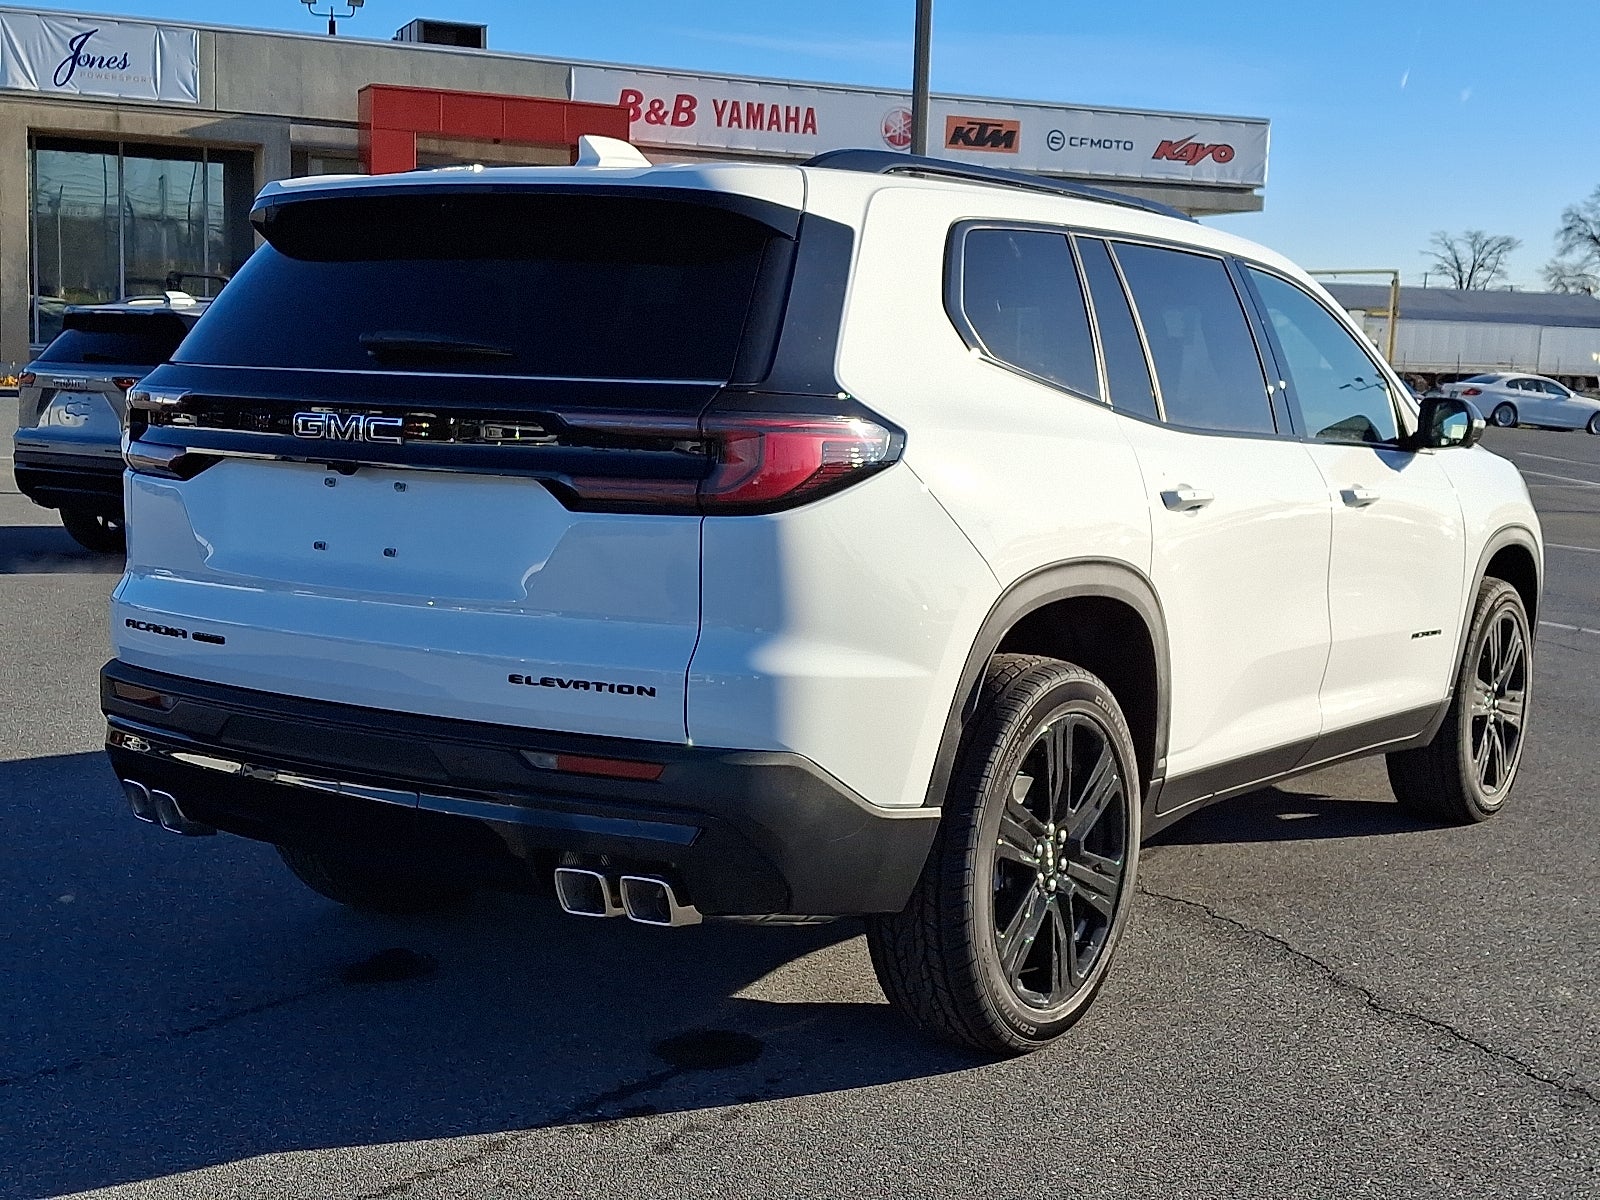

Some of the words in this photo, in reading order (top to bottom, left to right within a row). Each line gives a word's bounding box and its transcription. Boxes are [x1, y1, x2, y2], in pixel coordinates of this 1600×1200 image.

[53, 29, 131, 87] Jones
[619, 88, 698, 128] B&B
[712, 98, 818, 136] YAMAHA
[948, 121, 1017, 149] KTM
[1069, 136, 1134, 152] CFMOTO
[292, 411, 405, 445] GMC
[125, 619, 188, 639] ACADIA
[508, 673, 656, 698] ELEVATION
